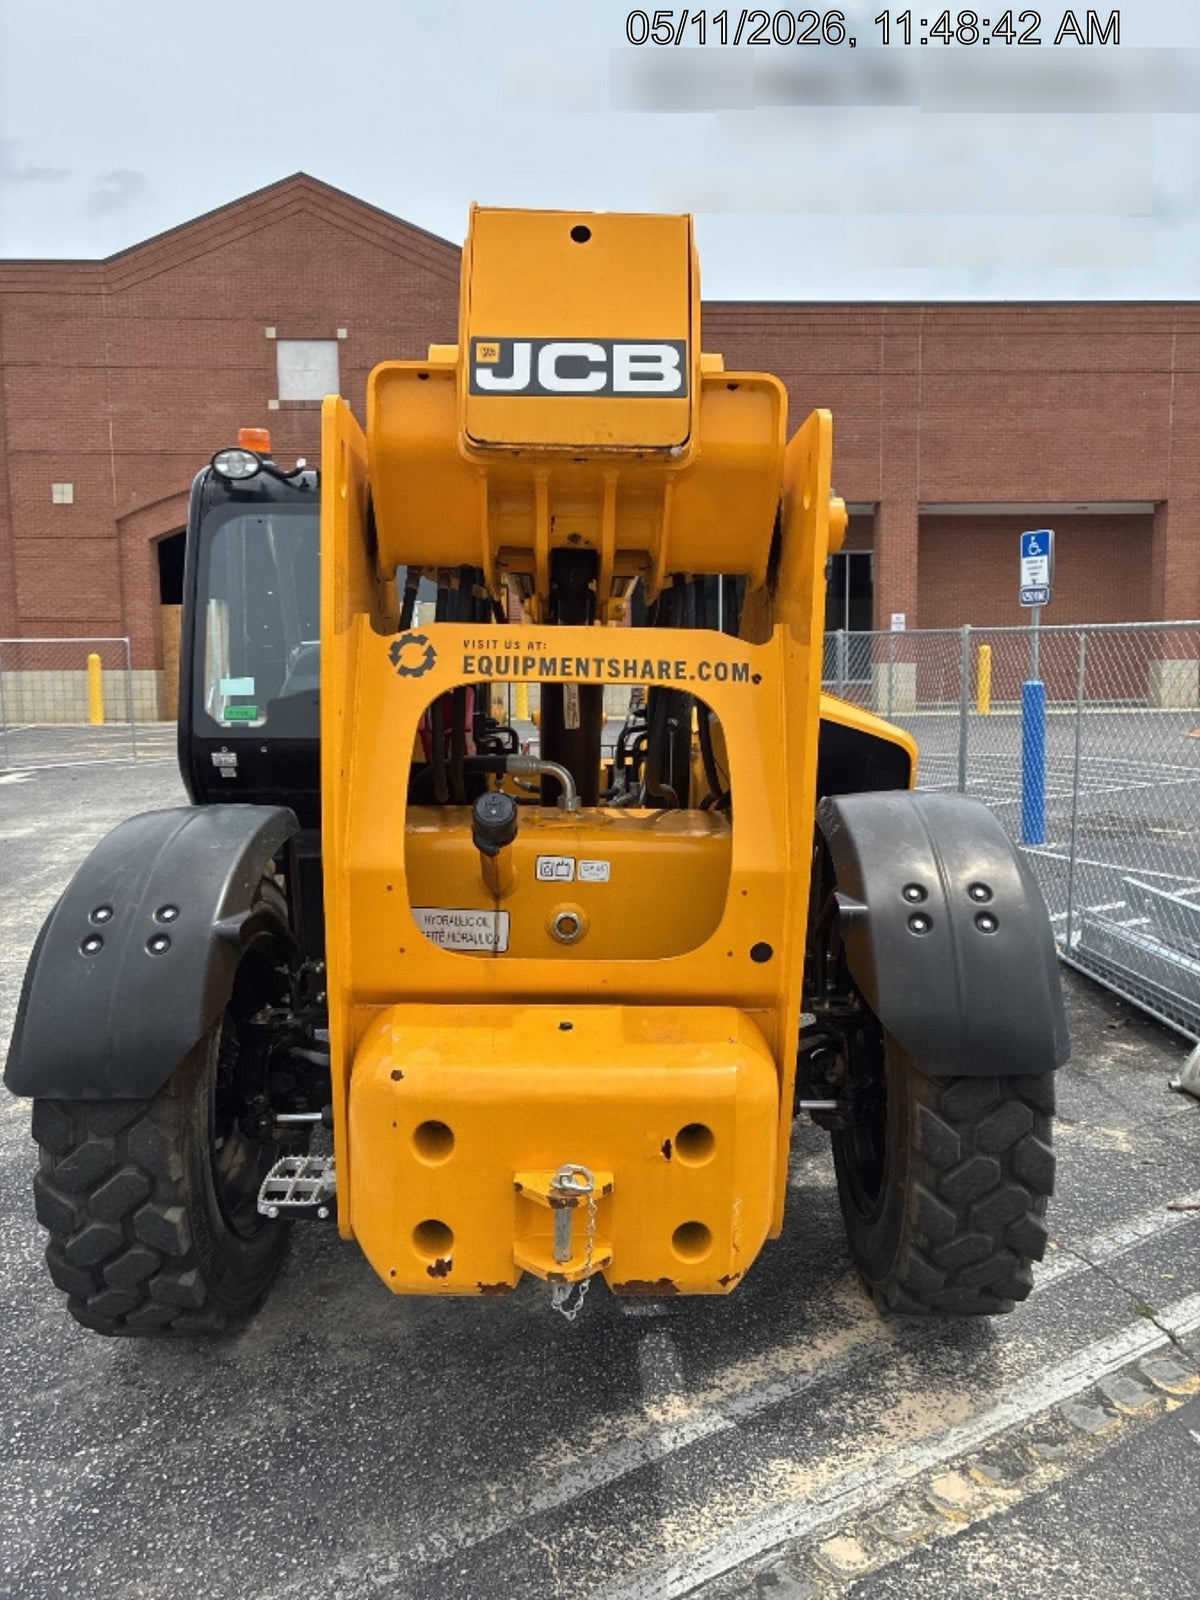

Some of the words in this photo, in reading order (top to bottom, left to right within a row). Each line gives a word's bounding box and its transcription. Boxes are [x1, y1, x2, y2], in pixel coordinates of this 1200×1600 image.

[475, 341, 682, 393] JCB
[463, 639, 499, 650] VISIT
[504, 640, 520, 650] US
[527, 641, 547, 651] AT:
[462, 654, 749, 682] EQUIPMENTSHARE.COM
[424, 914, 474, 927] HYDRAULIC
[475, 916, 489, 928] OIL
